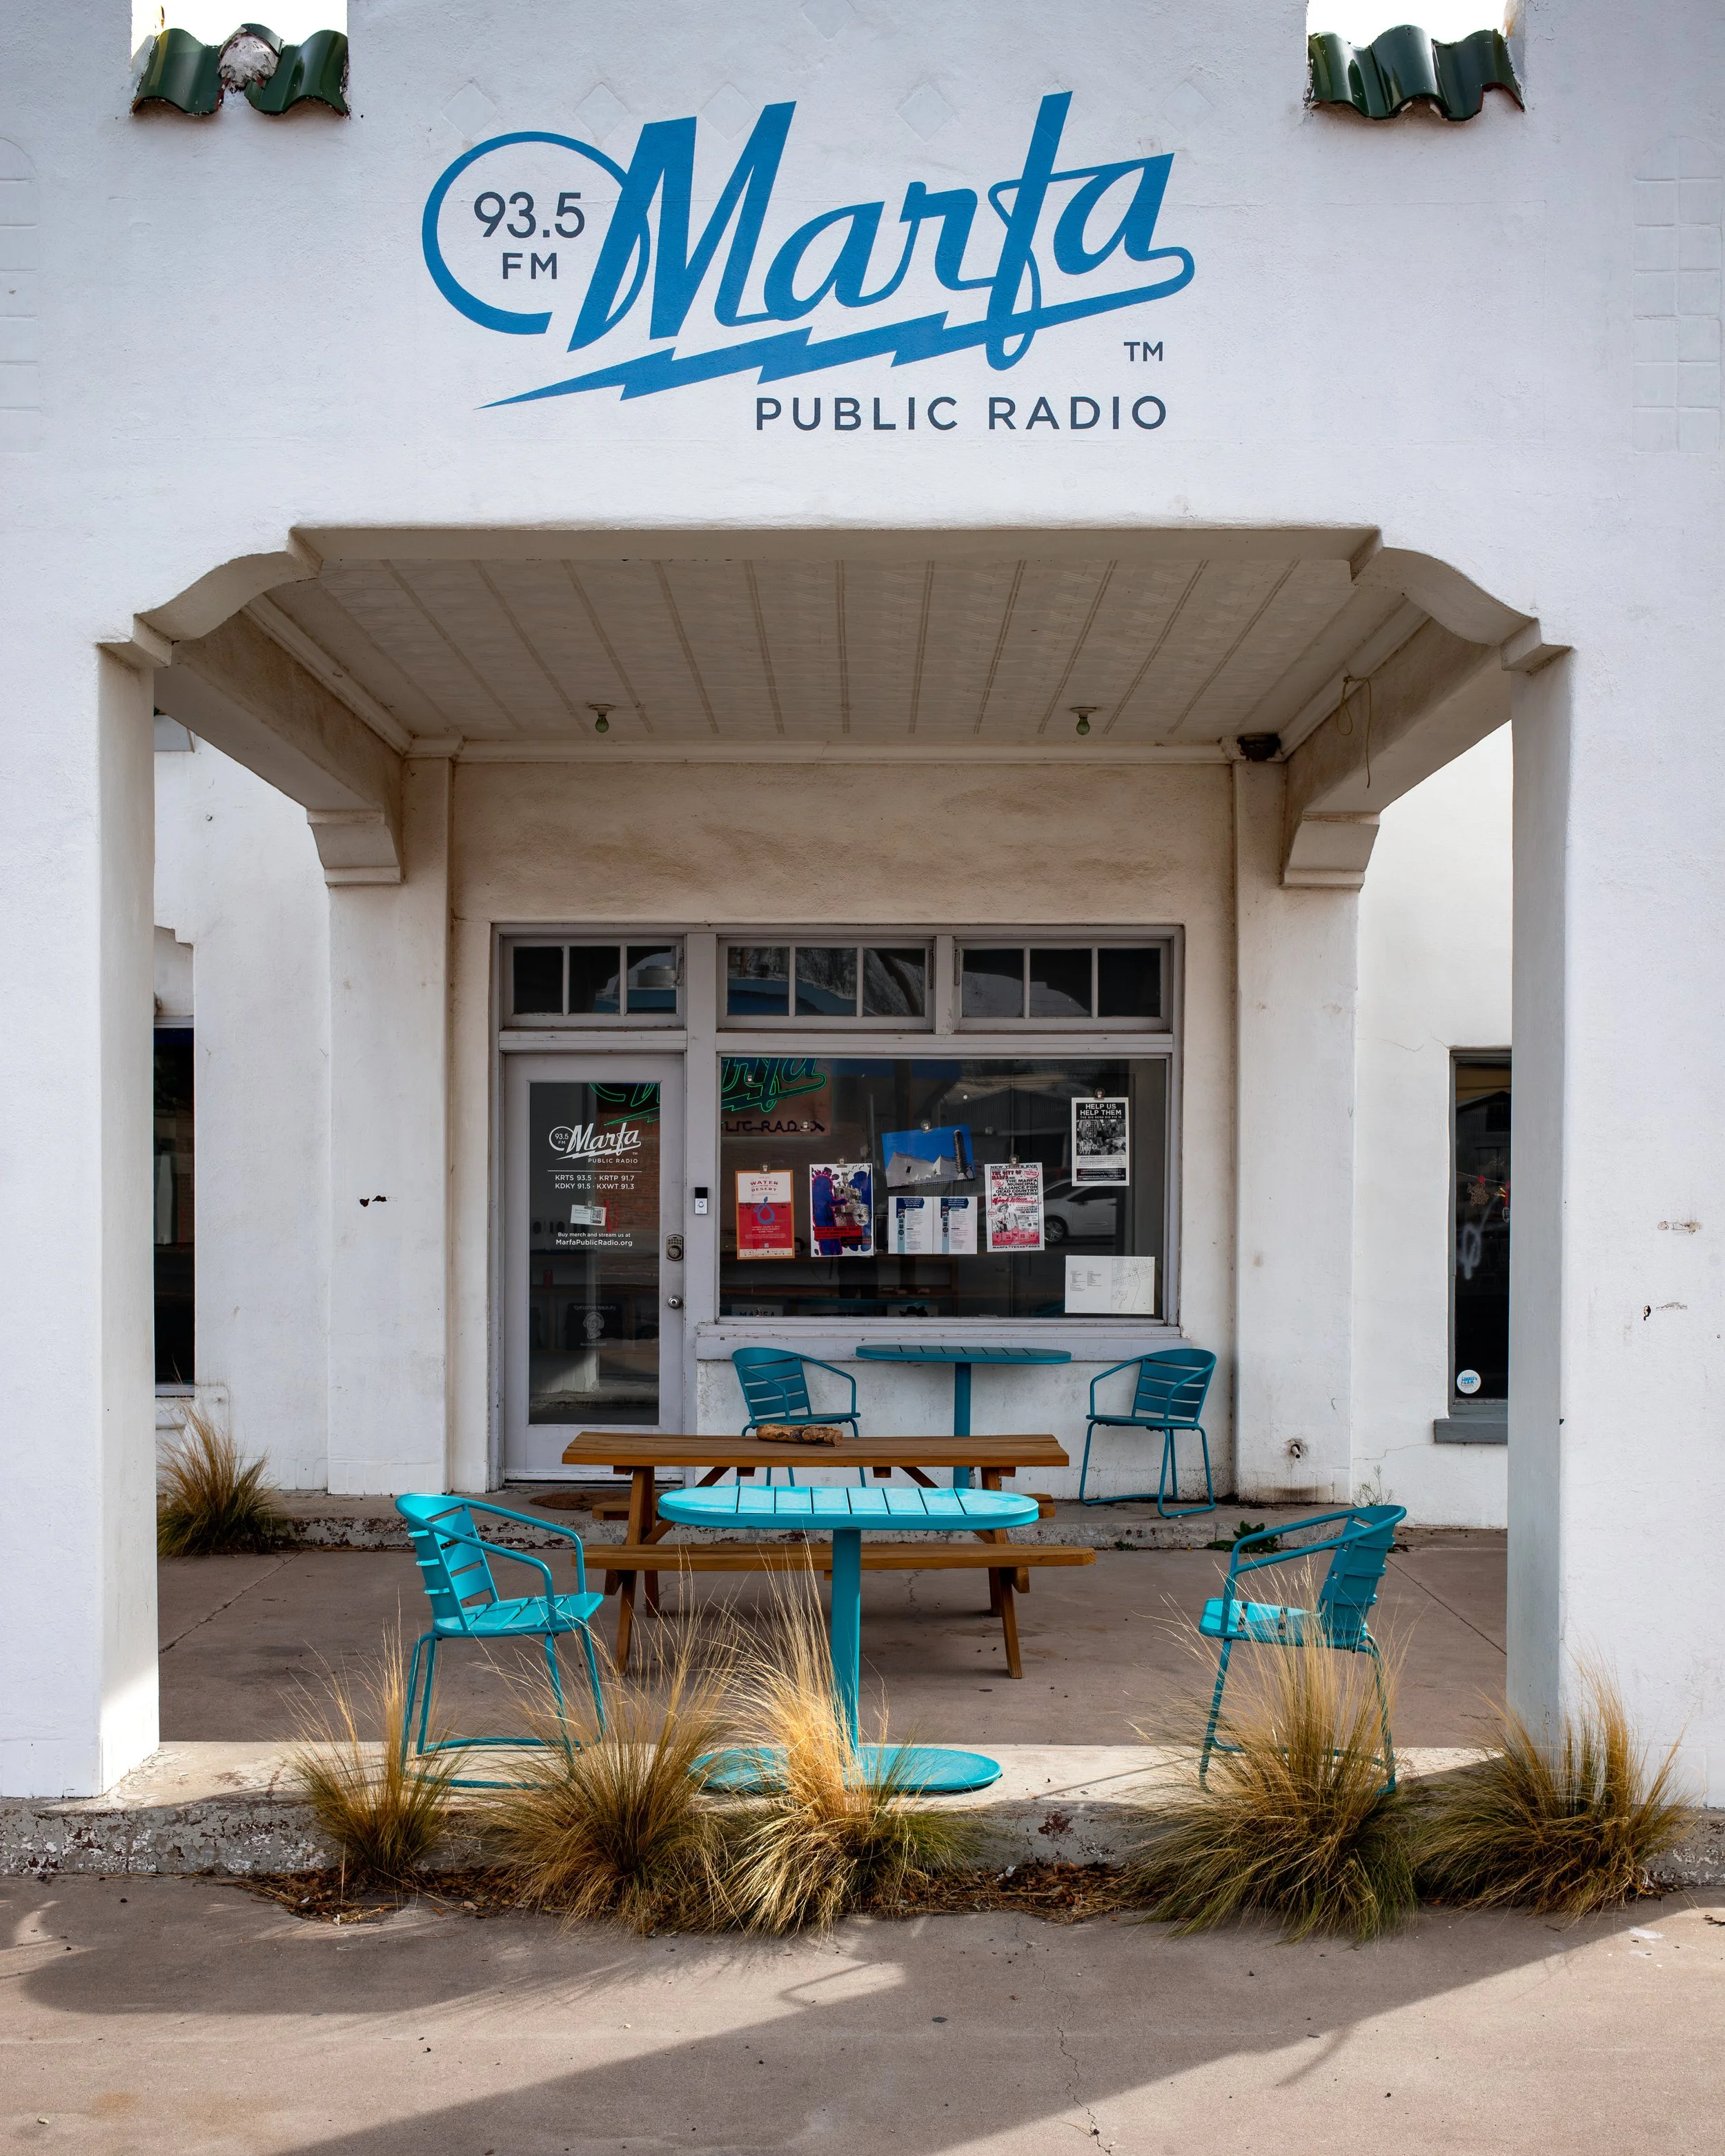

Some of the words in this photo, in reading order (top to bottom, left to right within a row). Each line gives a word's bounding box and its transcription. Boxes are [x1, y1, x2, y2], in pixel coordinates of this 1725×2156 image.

[473, 191, 586, 239] 93.5
[568, 91, 1195, 371] Marfa
[502, 252, 558, 280] FM
[1124, 341, 1164, 363] TM
[756, 396, 959, 431] PUBLIC
[988, 395, 1167, 431] RADIO
[566, 1122, 642, 1156] Marfa
